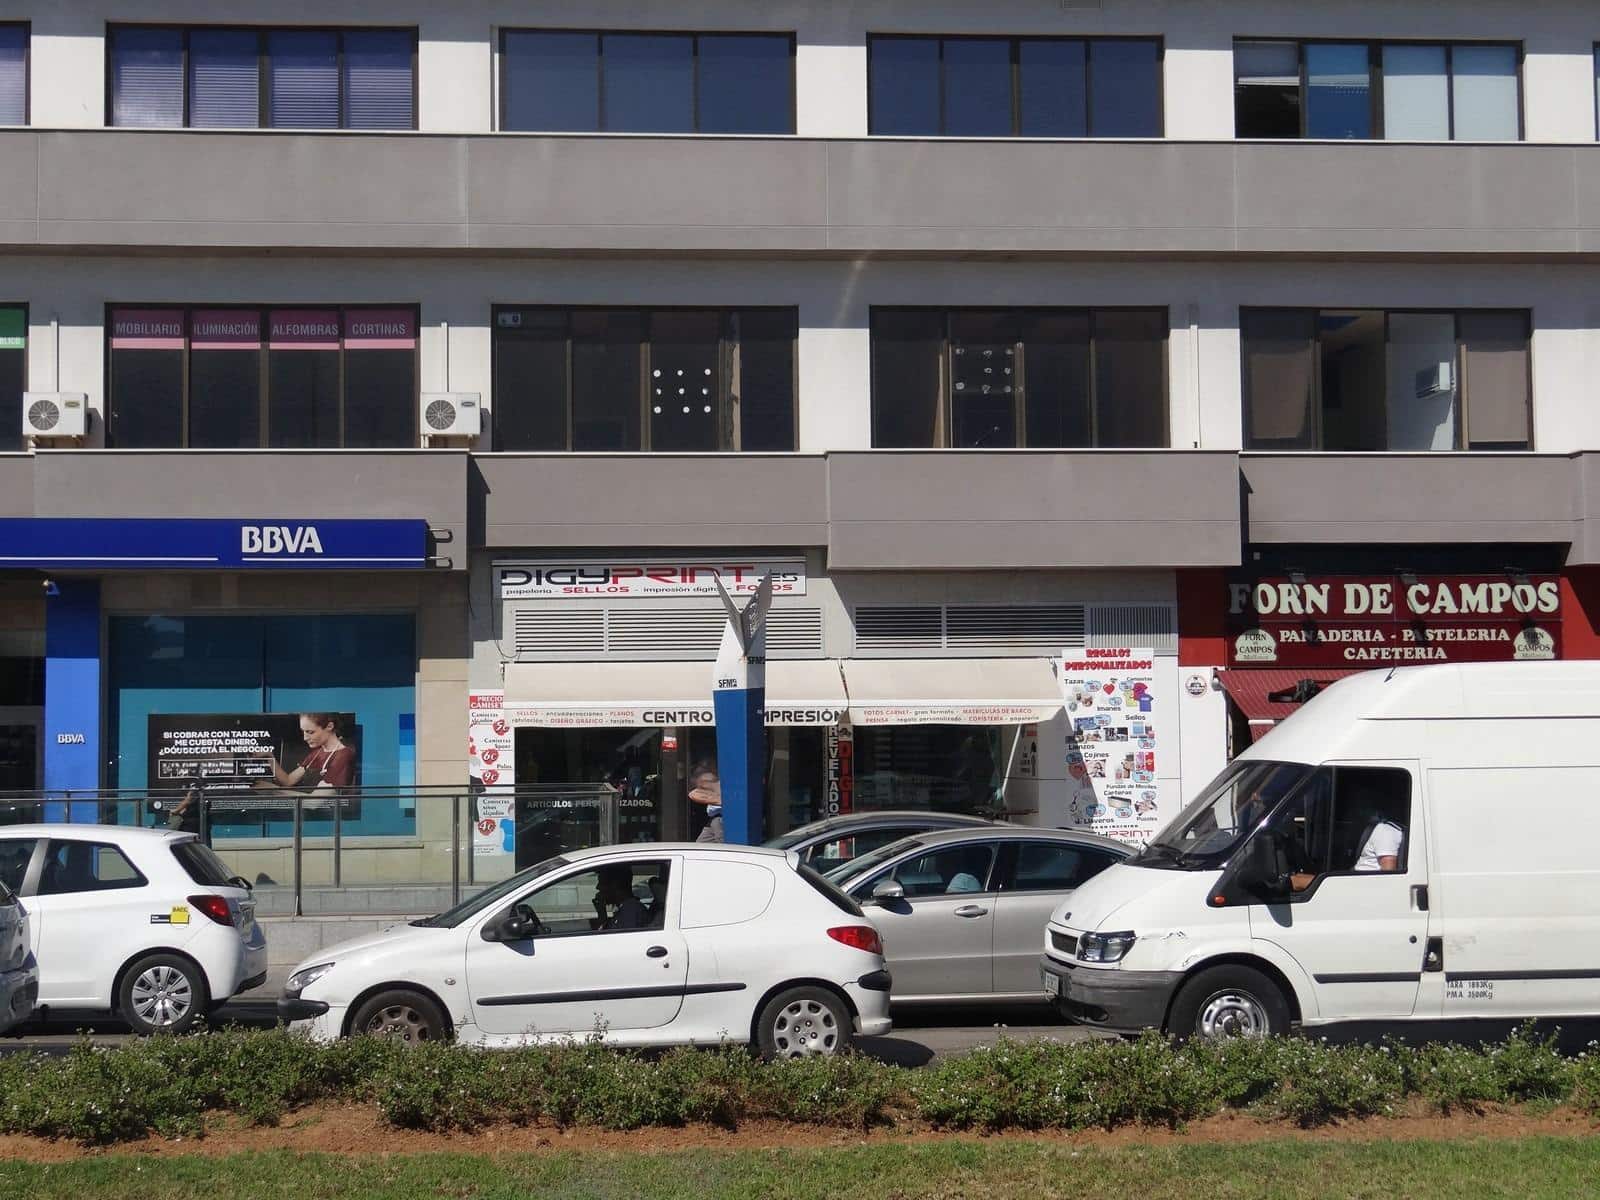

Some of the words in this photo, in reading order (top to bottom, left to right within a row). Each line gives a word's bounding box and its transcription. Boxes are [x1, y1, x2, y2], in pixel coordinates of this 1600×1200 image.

[115, 322, 181, 335] MOBILIARIO
[193, 320, 258, 335] ILUMINACIÓN
[272, 323, 339, 336] ALFOMBRAS
[352, 322, 406, 335] CORTINAS
[241, 526, 323, 553] BBVA
[562, 586, 630, 594] SELLOS
[1228, 583, 1330, 614] FORN
[1343, 583, 1393, 614] DE
[1407, 582, 1559, 614] CAMPOS
[1279, 629, 1385, 642] PANADERIA
[1402, 629, 1510, 641] PASTELERIA
[1086, 648, 1131, 658] REGALOS
[1239, 645, 1273, 653] CAMPOS
[1343, 647, 1448, 660] CAFETERIA
[1064, 660, 1152, 671] PERSONALIZADOS
[642, 710, 713, 724] CENTRO
[57, 733, 86, 744] BBVA
[173, 731, 210, 739] COBRAR
[210, 730, 230, 738] CON
[231, 730, 271, 738] TARJETA
[230, 745, 275, 753] NEGOCIO?
[246, 767, 265, 775] gratis
